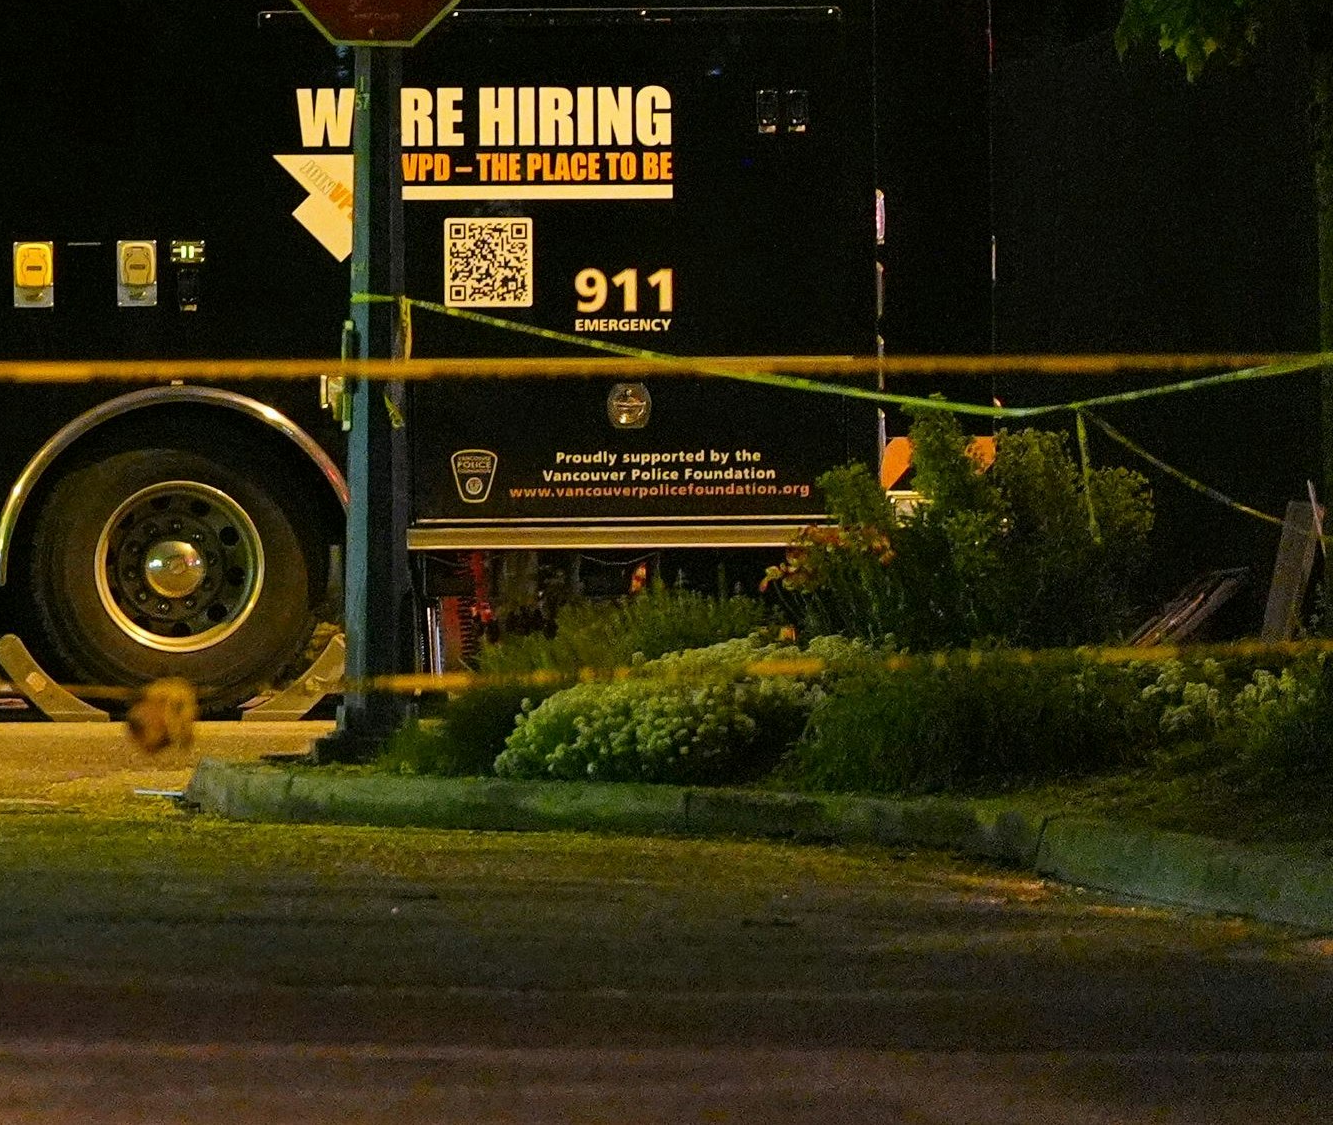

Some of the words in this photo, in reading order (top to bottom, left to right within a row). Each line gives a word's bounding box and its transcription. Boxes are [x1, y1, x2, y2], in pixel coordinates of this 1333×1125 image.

[479, 86, 672, 146] HIRING
[401, 153, 451, 182] VPD
[476, 152, 521, 181] THE
[527, 152, 601, 181] PLACE
[605, 151, 637, 181] TO
[643, 151, 673, 180] BE
[574, 267, 673, 313] 911
[574, 318, 672, 332] EMERGENCY
[457, 461, 492, 469] POLICE
[556, 451, 617, 466] Proudly
[622, 450, 705, 465] supported
[710, 449, 730, 465] by
[735, 449, 761, 461] the
[542, 470, 626, 482] Vancouver
[631, 468, 679, 481] Police
[684, 467, 776, 480] Foundation
[509, 483, 810, 499] www.vancouverpolicefoundation.org
